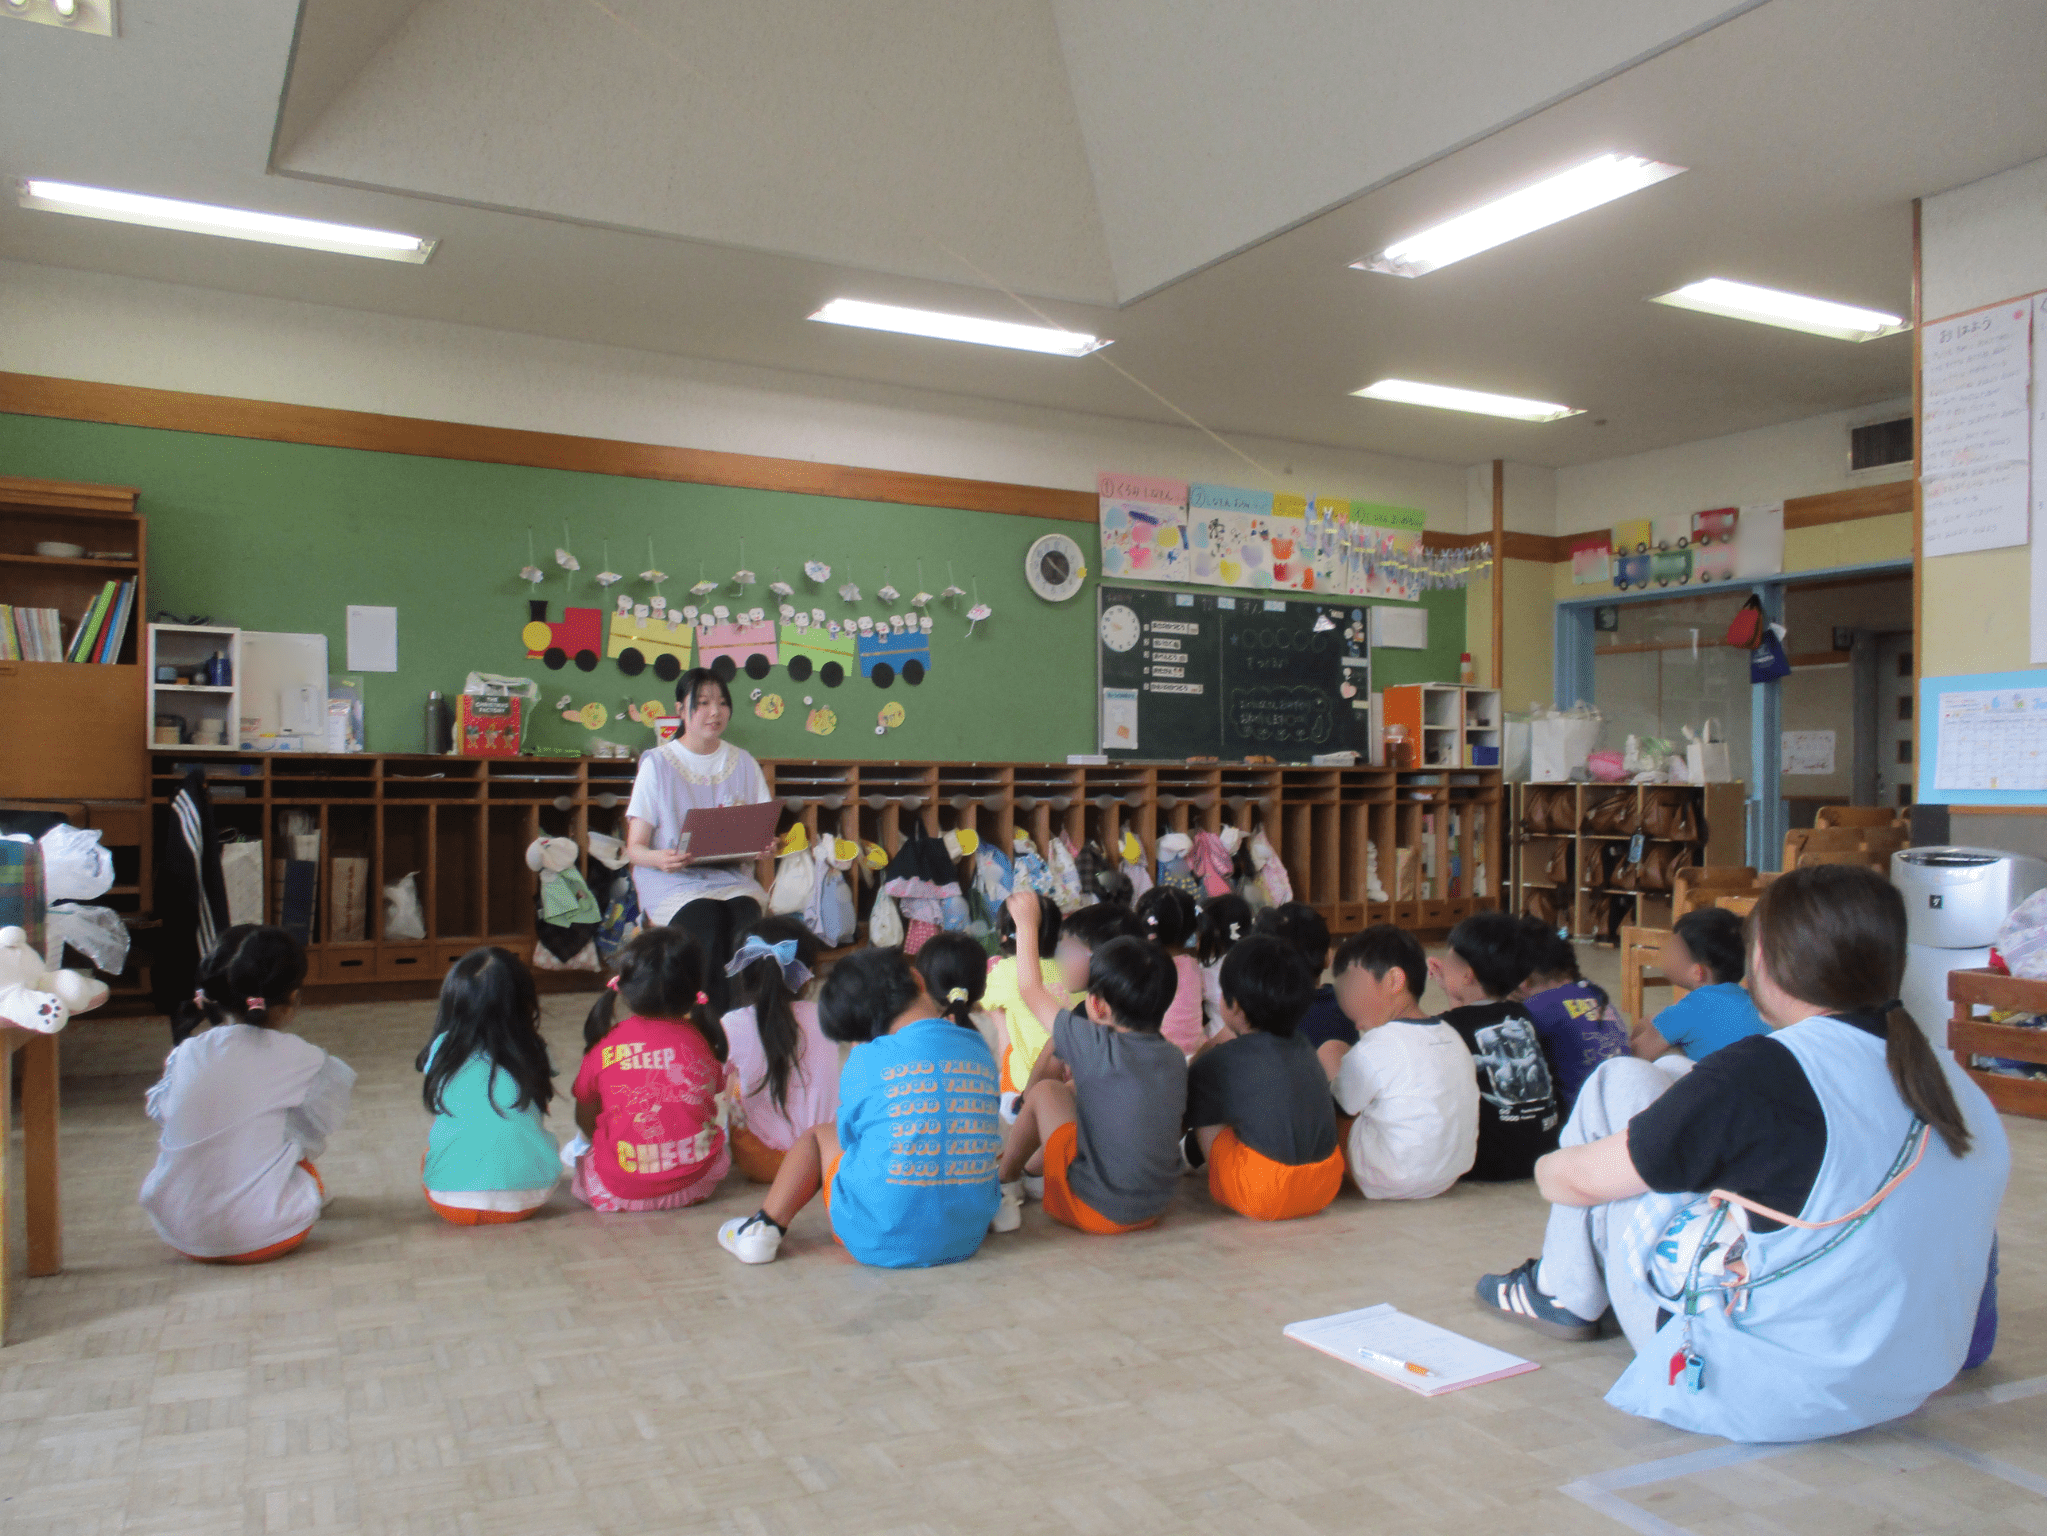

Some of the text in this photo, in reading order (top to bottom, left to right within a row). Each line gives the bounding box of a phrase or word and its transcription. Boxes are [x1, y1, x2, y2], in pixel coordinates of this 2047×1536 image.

[1939, 316, 1992, 344] おはよう
[602, 1042, 646, 1070] EAT
[620, 1047, 676, 1071] SLEEP
